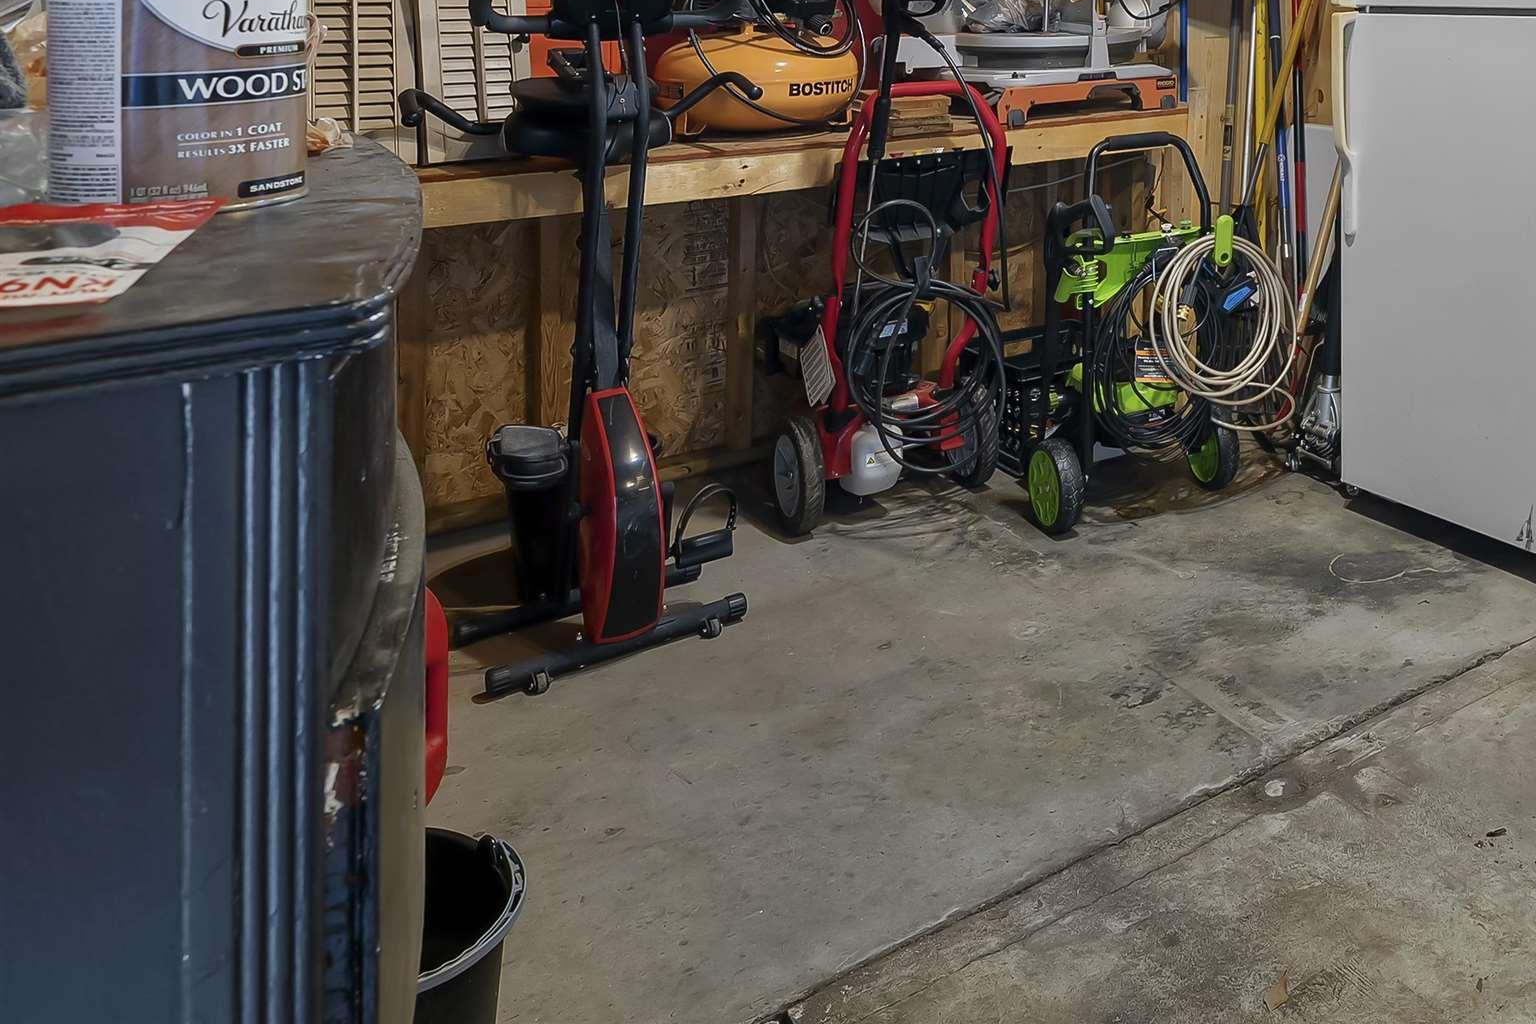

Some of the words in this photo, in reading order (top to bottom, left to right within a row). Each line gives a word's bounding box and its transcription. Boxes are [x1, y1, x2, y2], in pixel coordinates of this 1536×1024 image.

[177, 71, 289, 101] WOOD
[788, 78, 853, 97] BOSTITCH
[176, 131, 218, 142] COLOR
[220, 129, 233, 139] IN
[235, 126, 244, 138] 1
[247, 121, 284, 136] COAT
[177, 148, 226, 160] RESULTS
[228, 143, 248, 155] 3X
[250, 136, 291, 153] FASTER
[249, 175, 303, 194] SANDSTONE
